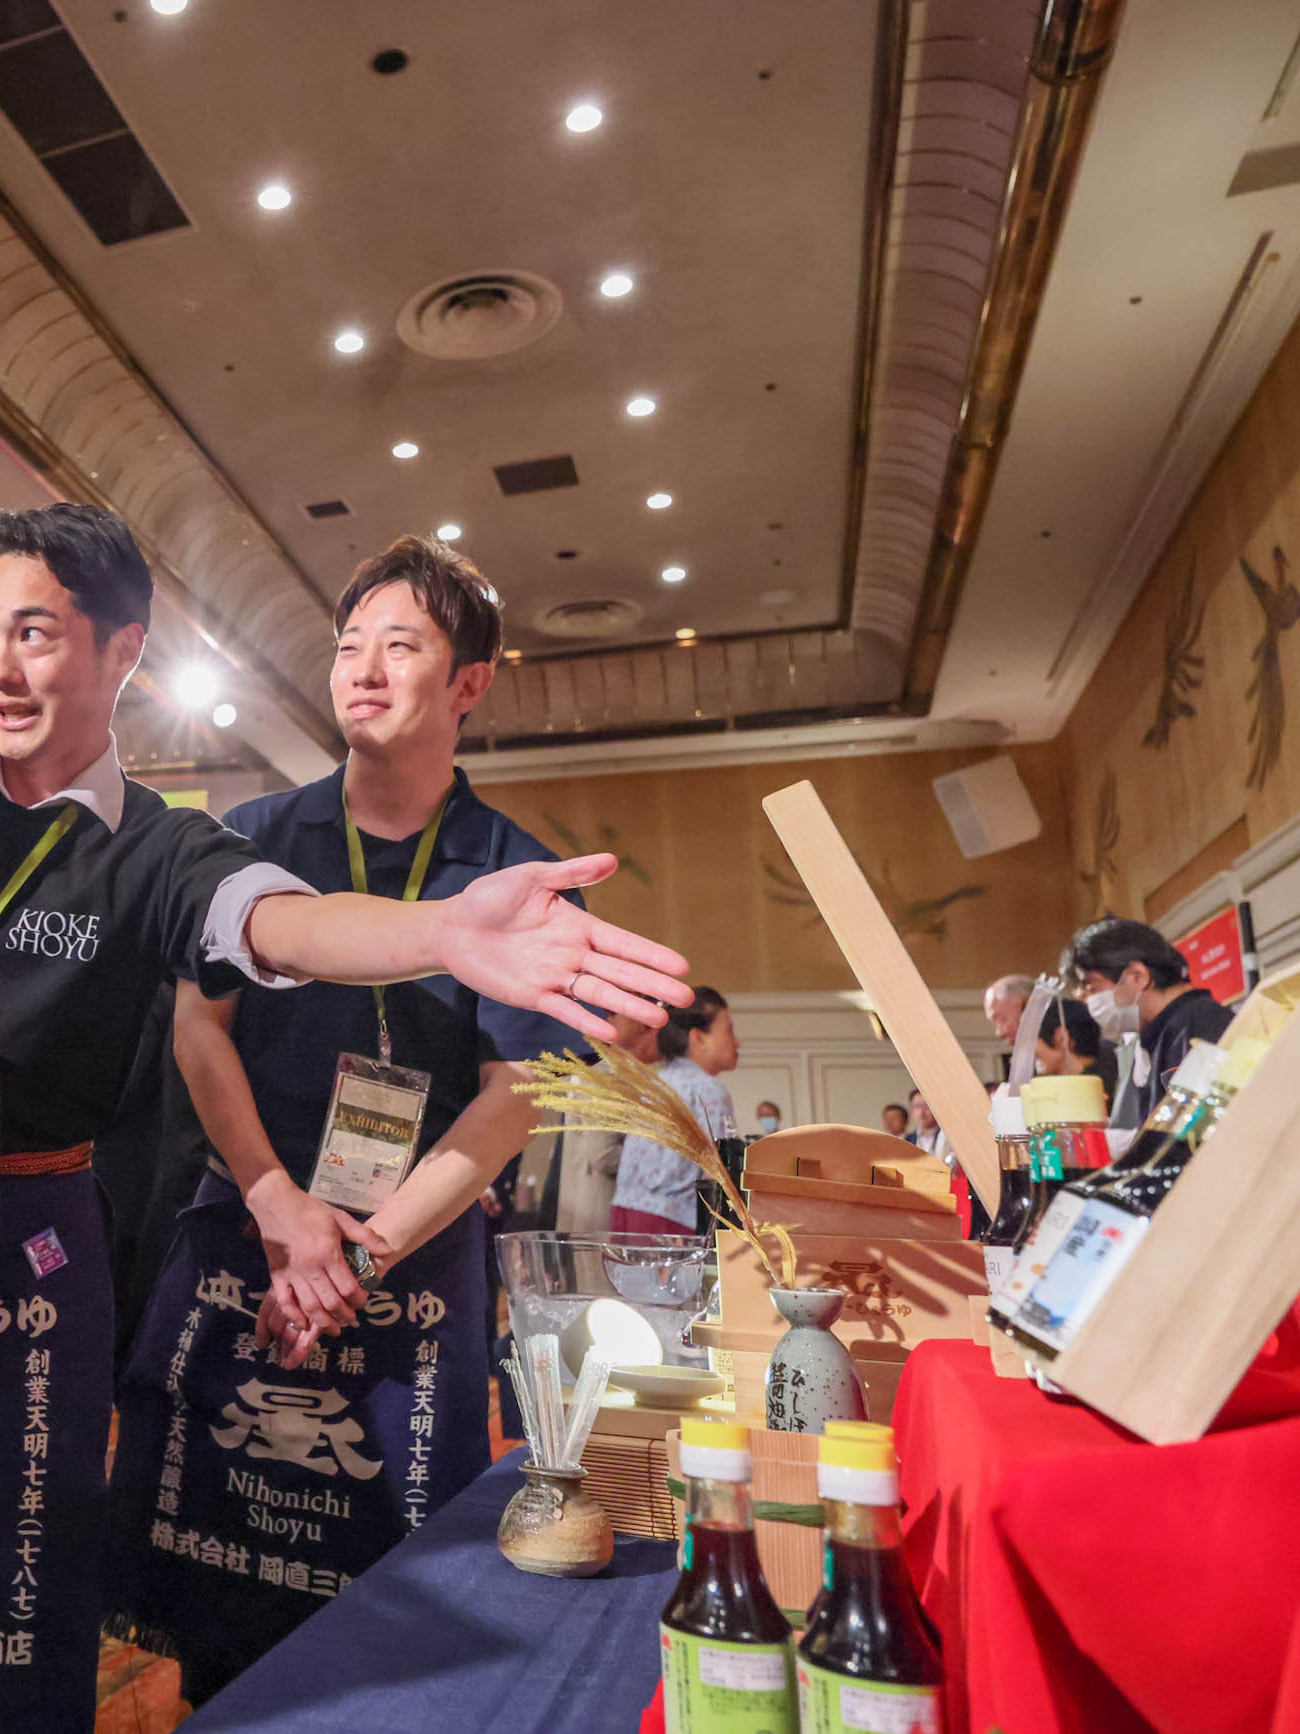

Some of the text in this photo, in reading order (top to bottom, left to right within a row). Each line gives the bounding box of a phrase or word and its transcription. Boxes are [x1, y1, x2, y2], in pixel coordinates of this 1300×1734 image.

[17, 908, 100, 940] KIOKE
[5, 927, 100, 962] SHOYU
[339, 1111, 409, 1138] EXHIBITOR
[227, 1467, 350, 1519] Nihonichi
[247, 1504, 322, 1543] Shoyu
[150, 1518, 250, 1575] 株式会社
